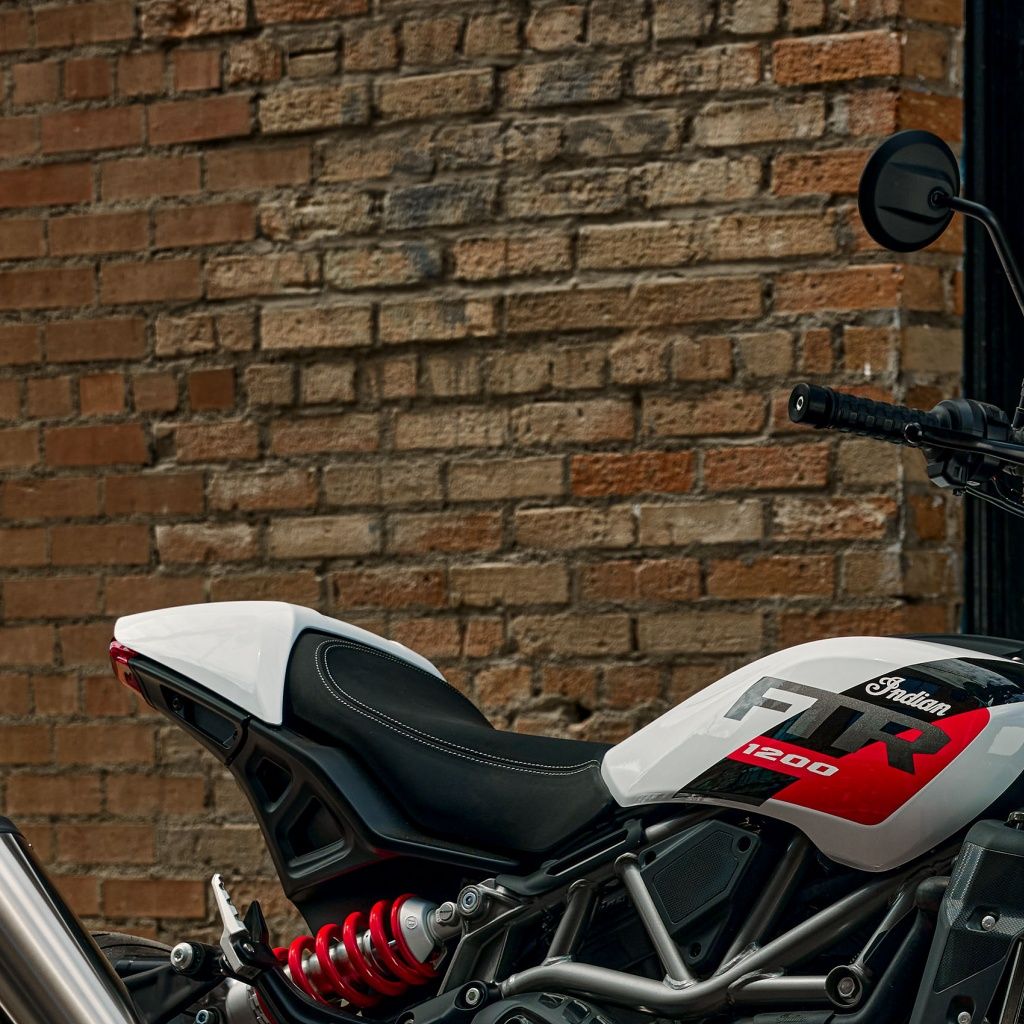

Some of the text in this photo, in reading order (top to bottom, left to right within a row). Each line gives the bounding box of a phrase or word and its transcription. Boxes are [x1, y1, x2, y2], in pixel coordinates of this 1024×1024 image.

[865, 678, 952, 716] Indian
[724, 676, 952, 774] FTR
[742, 744, 839, 777] 1200
